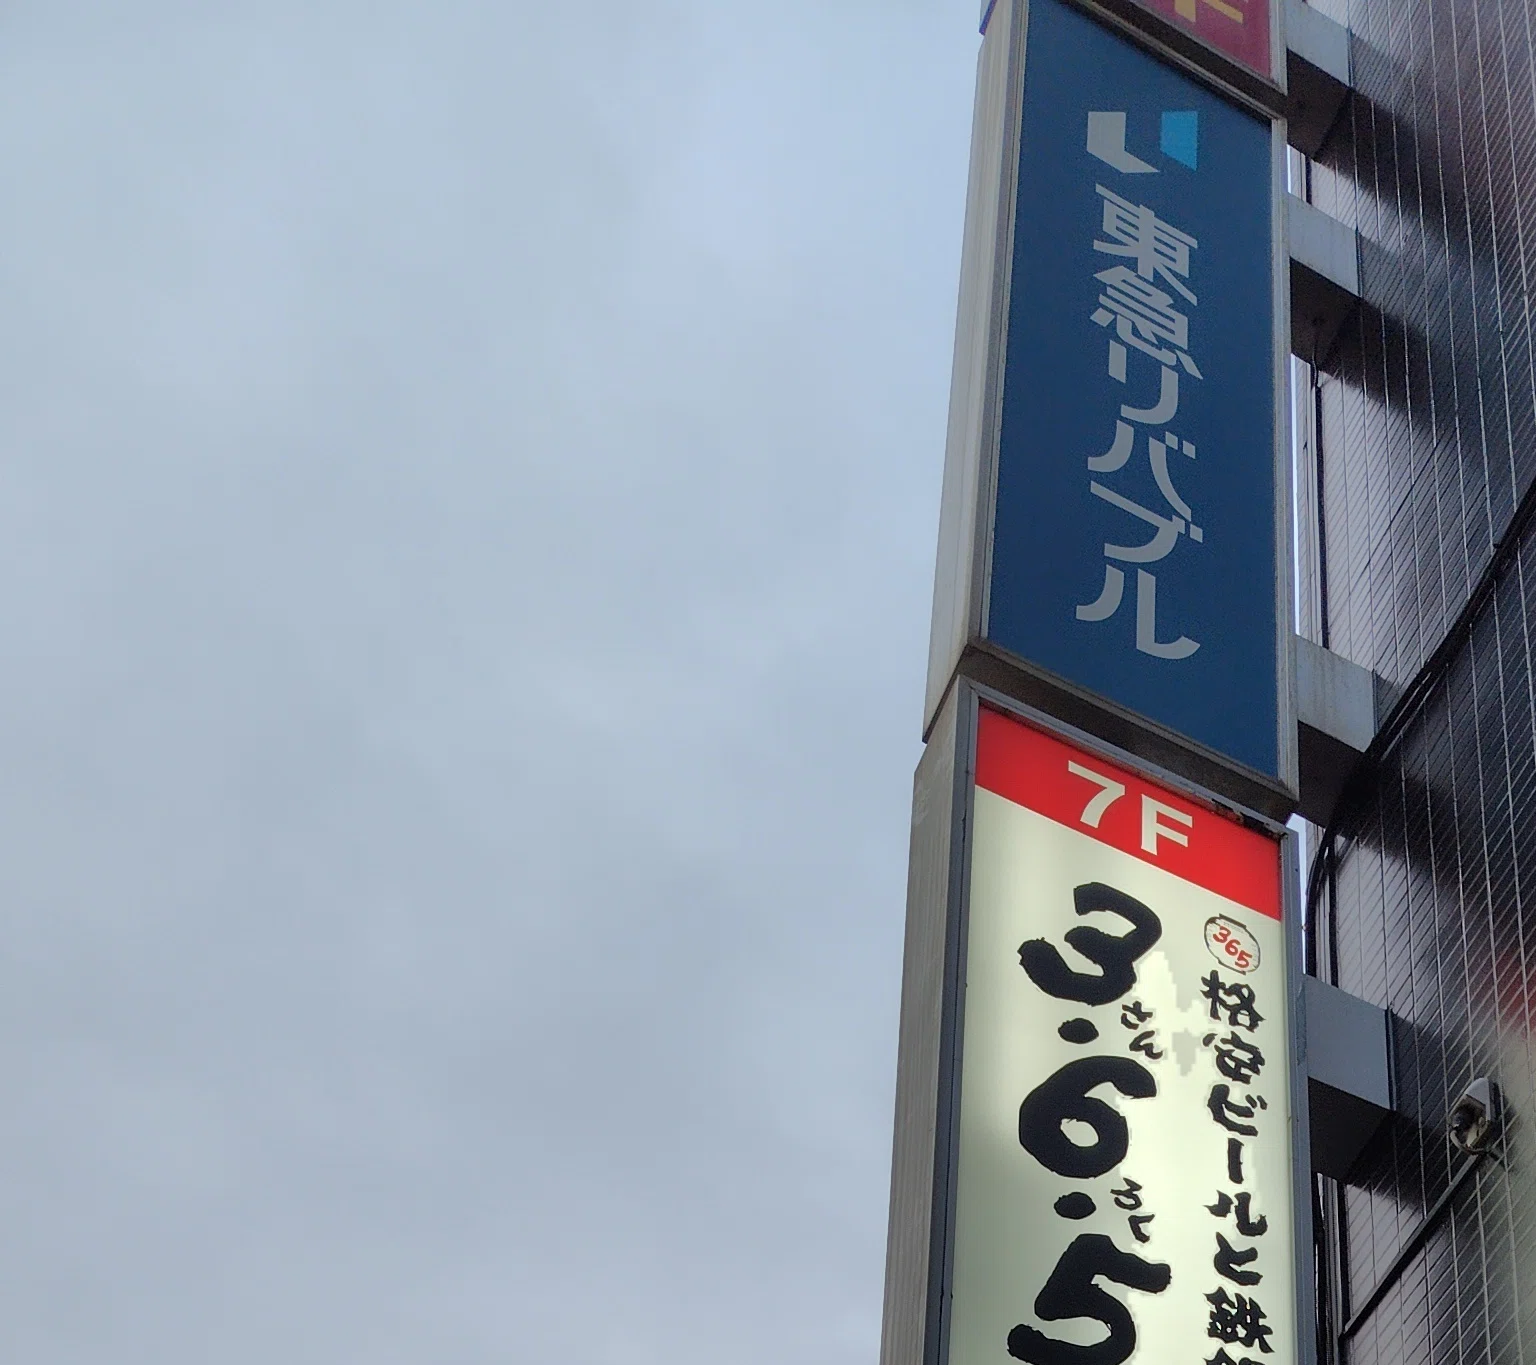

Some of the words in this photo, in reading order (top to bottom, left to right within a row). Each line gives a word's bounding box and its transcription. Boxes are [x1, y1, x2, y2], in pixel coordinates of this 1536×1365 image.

[1076, 183, 1203, 660] 東急リバブル
[1067, 760, 1193, 856] 7F
[1212, 925, 1253, 968] 365
